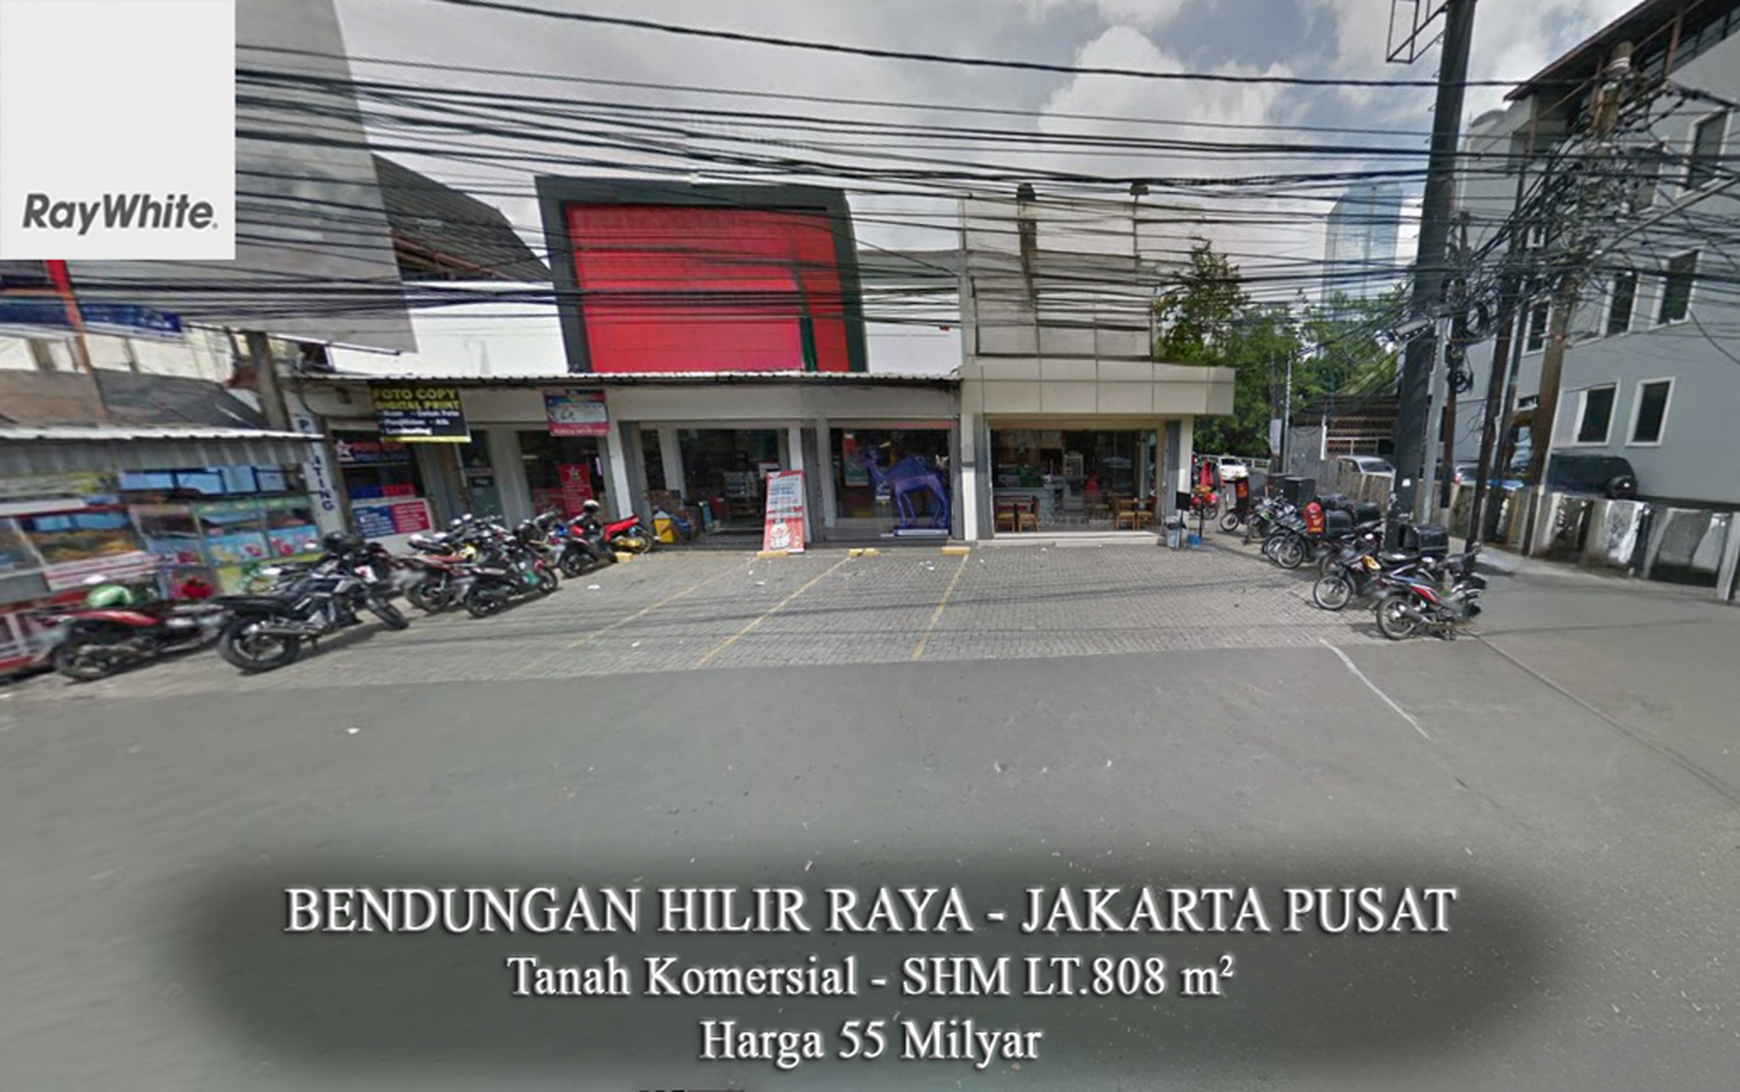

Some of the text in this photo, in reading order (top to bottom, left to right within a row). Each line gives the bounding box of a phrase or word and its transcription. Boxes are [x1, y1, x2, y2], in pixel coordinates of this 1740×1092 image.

[372, 389, 456, 399] FOTO COPY
[424, 401, 461, 410] PRINT
